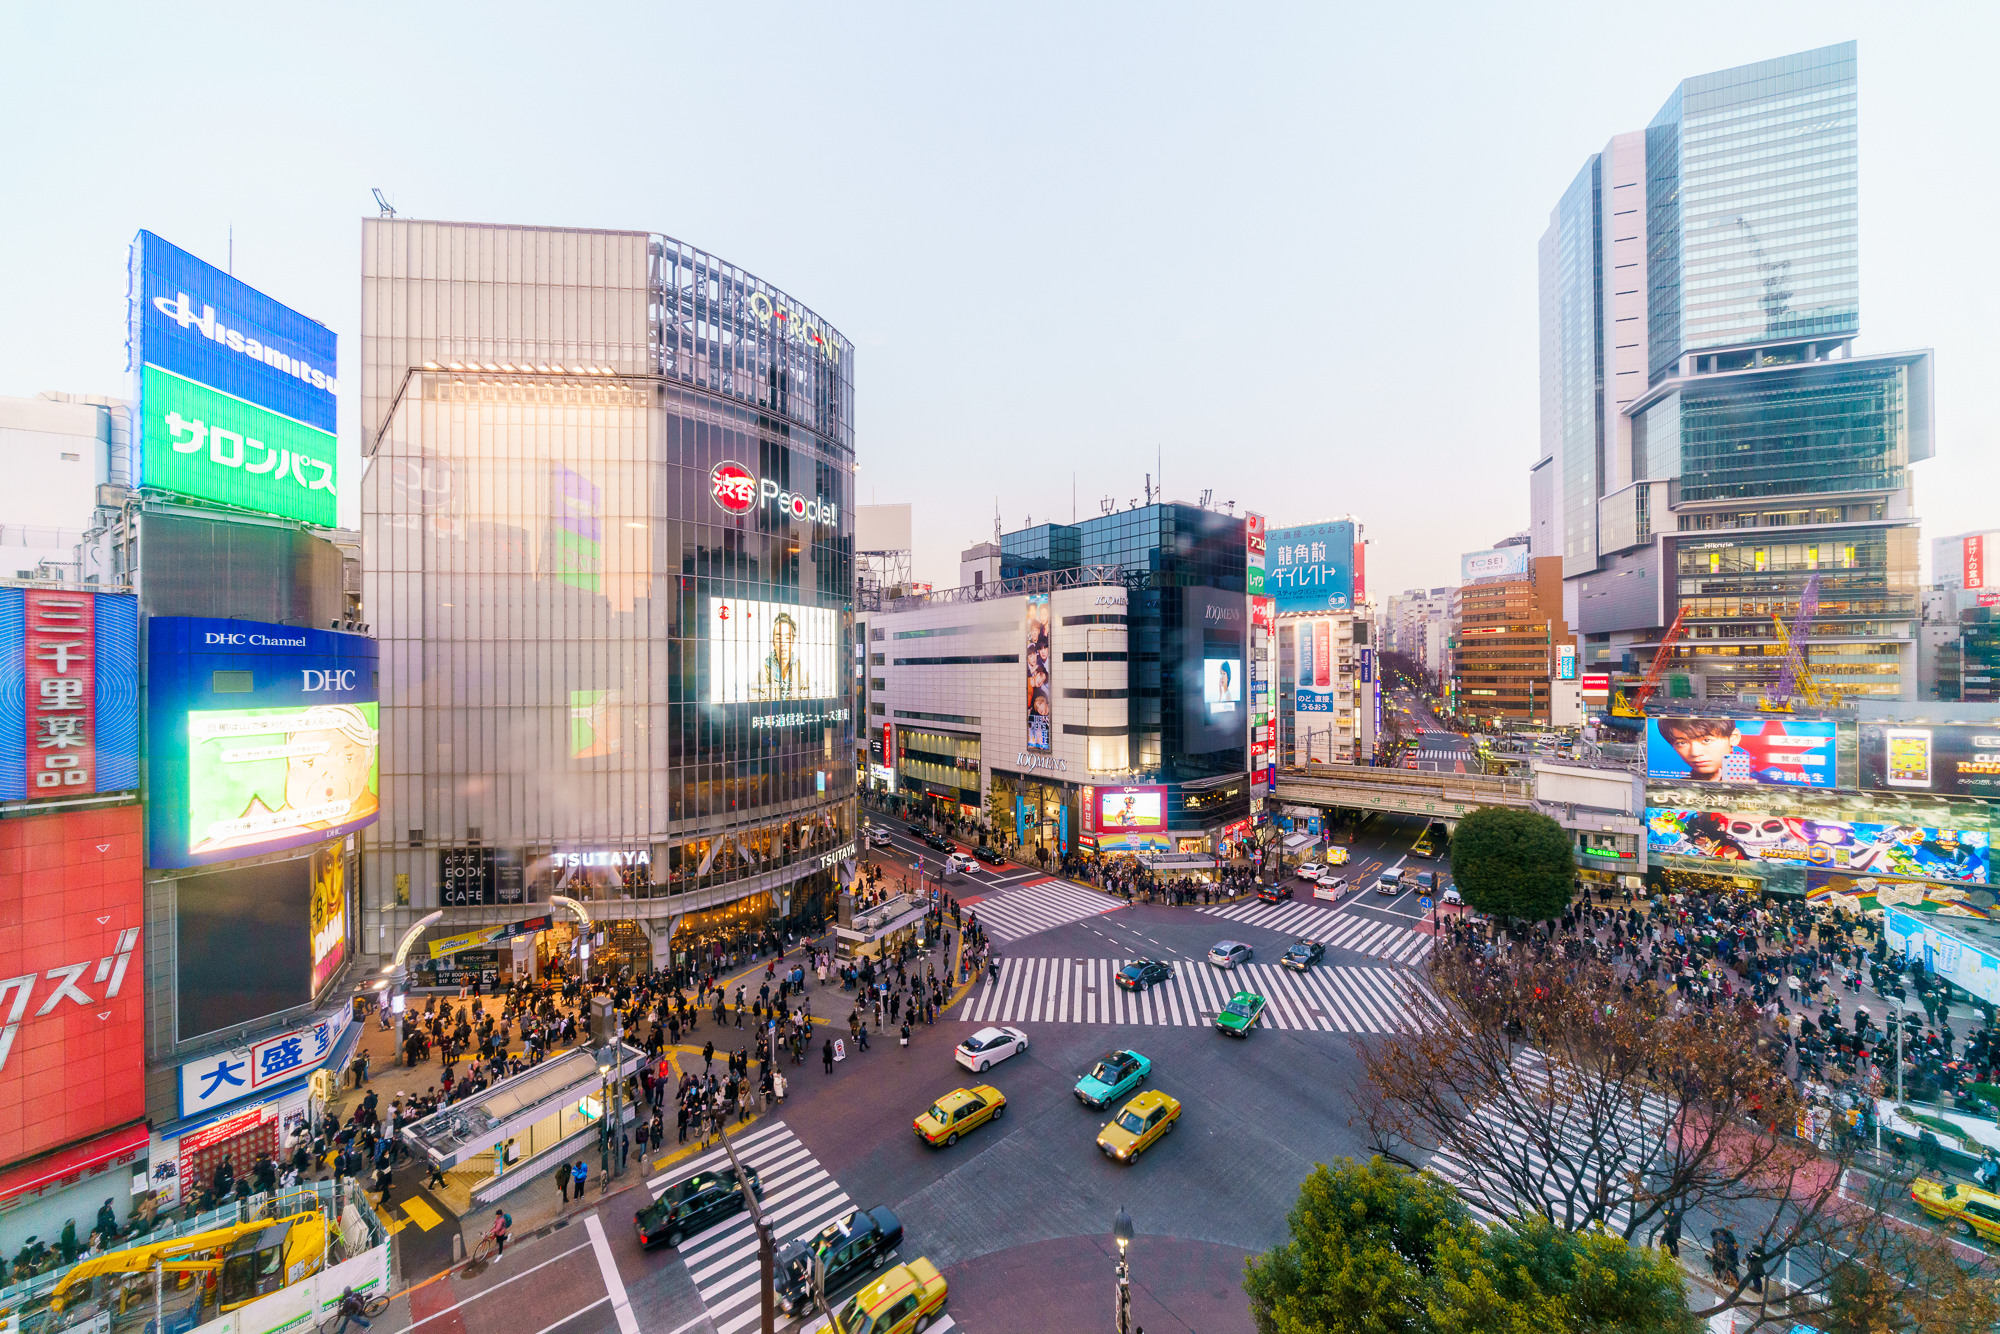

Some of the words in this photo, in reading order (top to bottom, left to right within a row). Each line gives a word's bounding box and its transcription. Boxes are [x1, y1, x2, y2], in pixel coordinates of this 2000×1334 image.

[153, 291, 340, 396] Hisamitsu
[165, 411, 337, 496] サロンパス
[712, 471, 756, 503] 渋谷
[1250, 536, 1267, 551] アコム
[1278, 541, 1327, 566] 龍角散
[1471, 557, 1503, 567] TOSEI
[1968, 538, 1980, 587] ほけんの窓口
[1249, 574, 1264, 587] レイク
[1271, 564, 1336, 588] ダイレクト
[1329, 596, 1346, 605] 生薬
[205, 632, 246, 645] DHC
[249, 634, 306, 647] Channel
[302, 669, 356, 692] DHC
[36, 600, 88, 787] 三千里薬品
[1301, 703, 1328, 711] うるおう
[1770, 771, 1826, 783] 学割先生
[1653, 792, 1681, 804] JR
[1684, 793, 1735, 807] 渋谷駅
[1738, 800, 1781, 811] shibuya
[1784, 804, 1823, 813] station
[326, 827, 343, 838] DHC
[554, 849, 651, 868] TSUTAYA
[820, 843, 857, 869] TSUTAYA
[1760, 848, 1808, 859] ROYALE
[445, 867, 487, 878] BOOK
[445, 891, 482, 901] CAFE
[315, 911, 343, 965] DMM
[183, 1112, 260, 1145] リクルートのフリーペーパー
